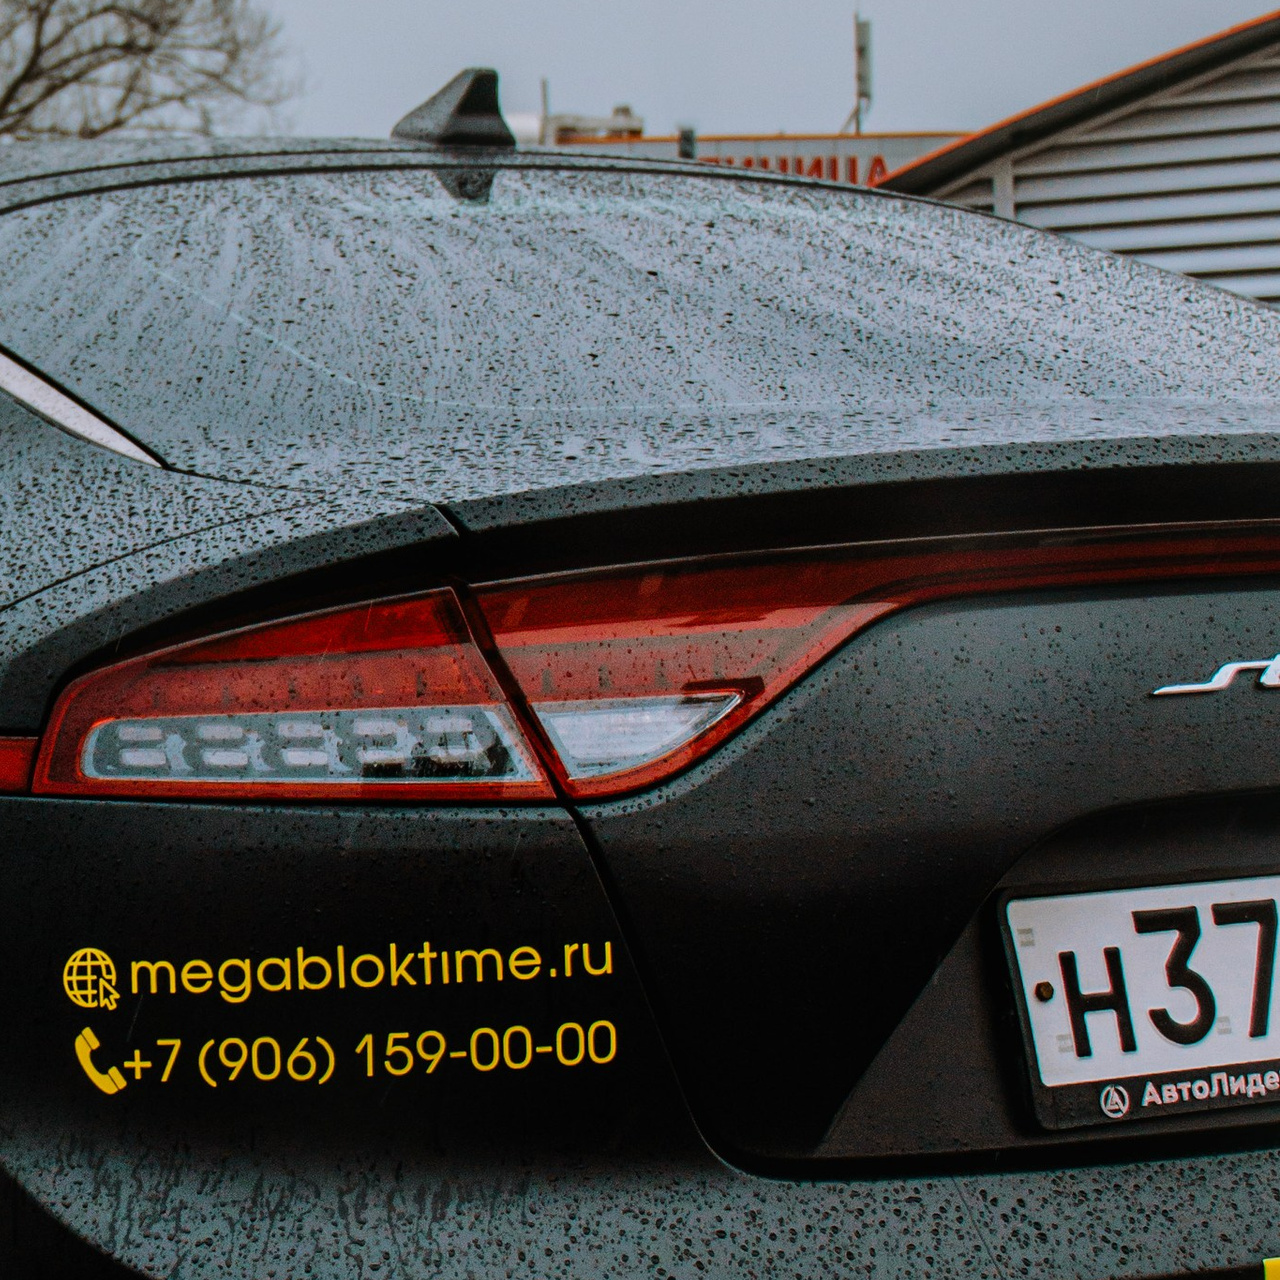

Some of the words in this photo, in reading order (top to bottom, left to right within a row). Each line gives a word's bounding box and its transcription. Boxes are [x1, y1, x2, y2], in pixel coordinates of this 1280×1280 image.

[130, 941, 613, 1004] megabloktime.ru
[123, 1038, 182, 1083] +7
[198, 1036, 336, 1088] (906)
[355, 1020, 617, 1077] 159-00-00
